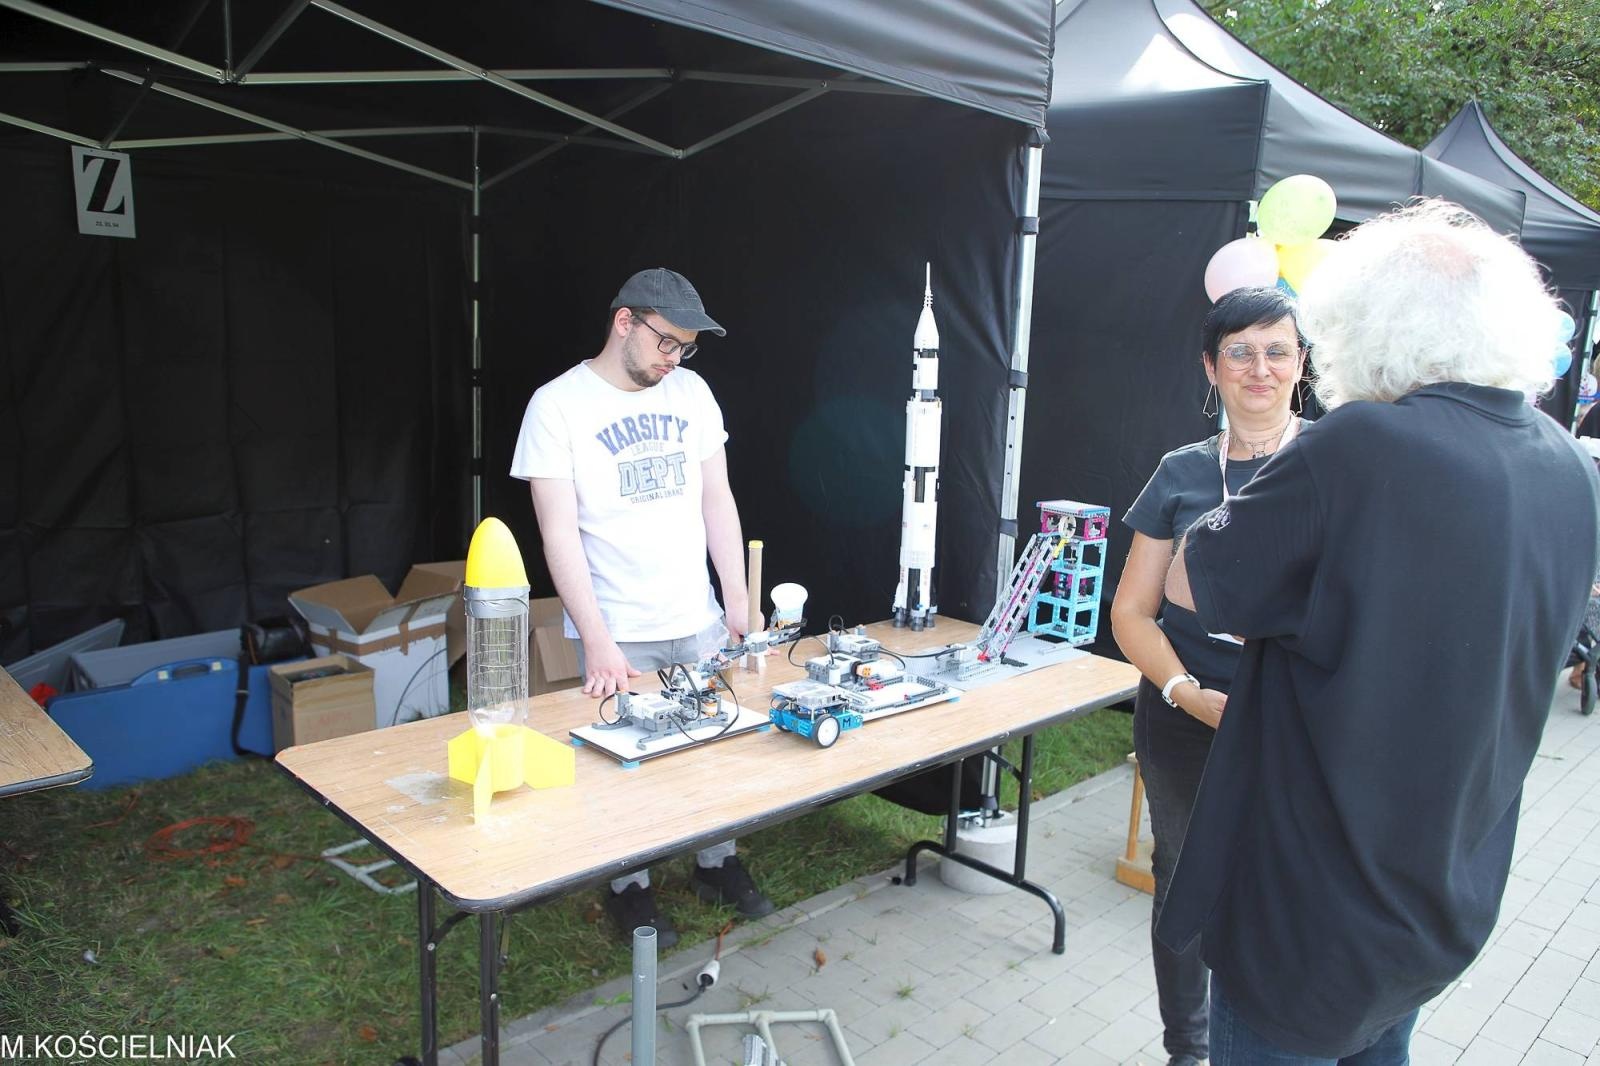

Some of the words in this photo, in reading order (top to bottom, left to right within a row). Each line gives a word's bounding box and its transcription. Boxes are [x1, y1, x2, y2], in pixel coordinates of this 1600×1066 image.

[83, 154, 125, 215] Z
[595, 413, 689, 456] VARSITY
[630, 441, 665, 456] LEAGUE
[618, 451, 686, 497] DEPT
[630, 491, 664, 504] ORIGINAL
